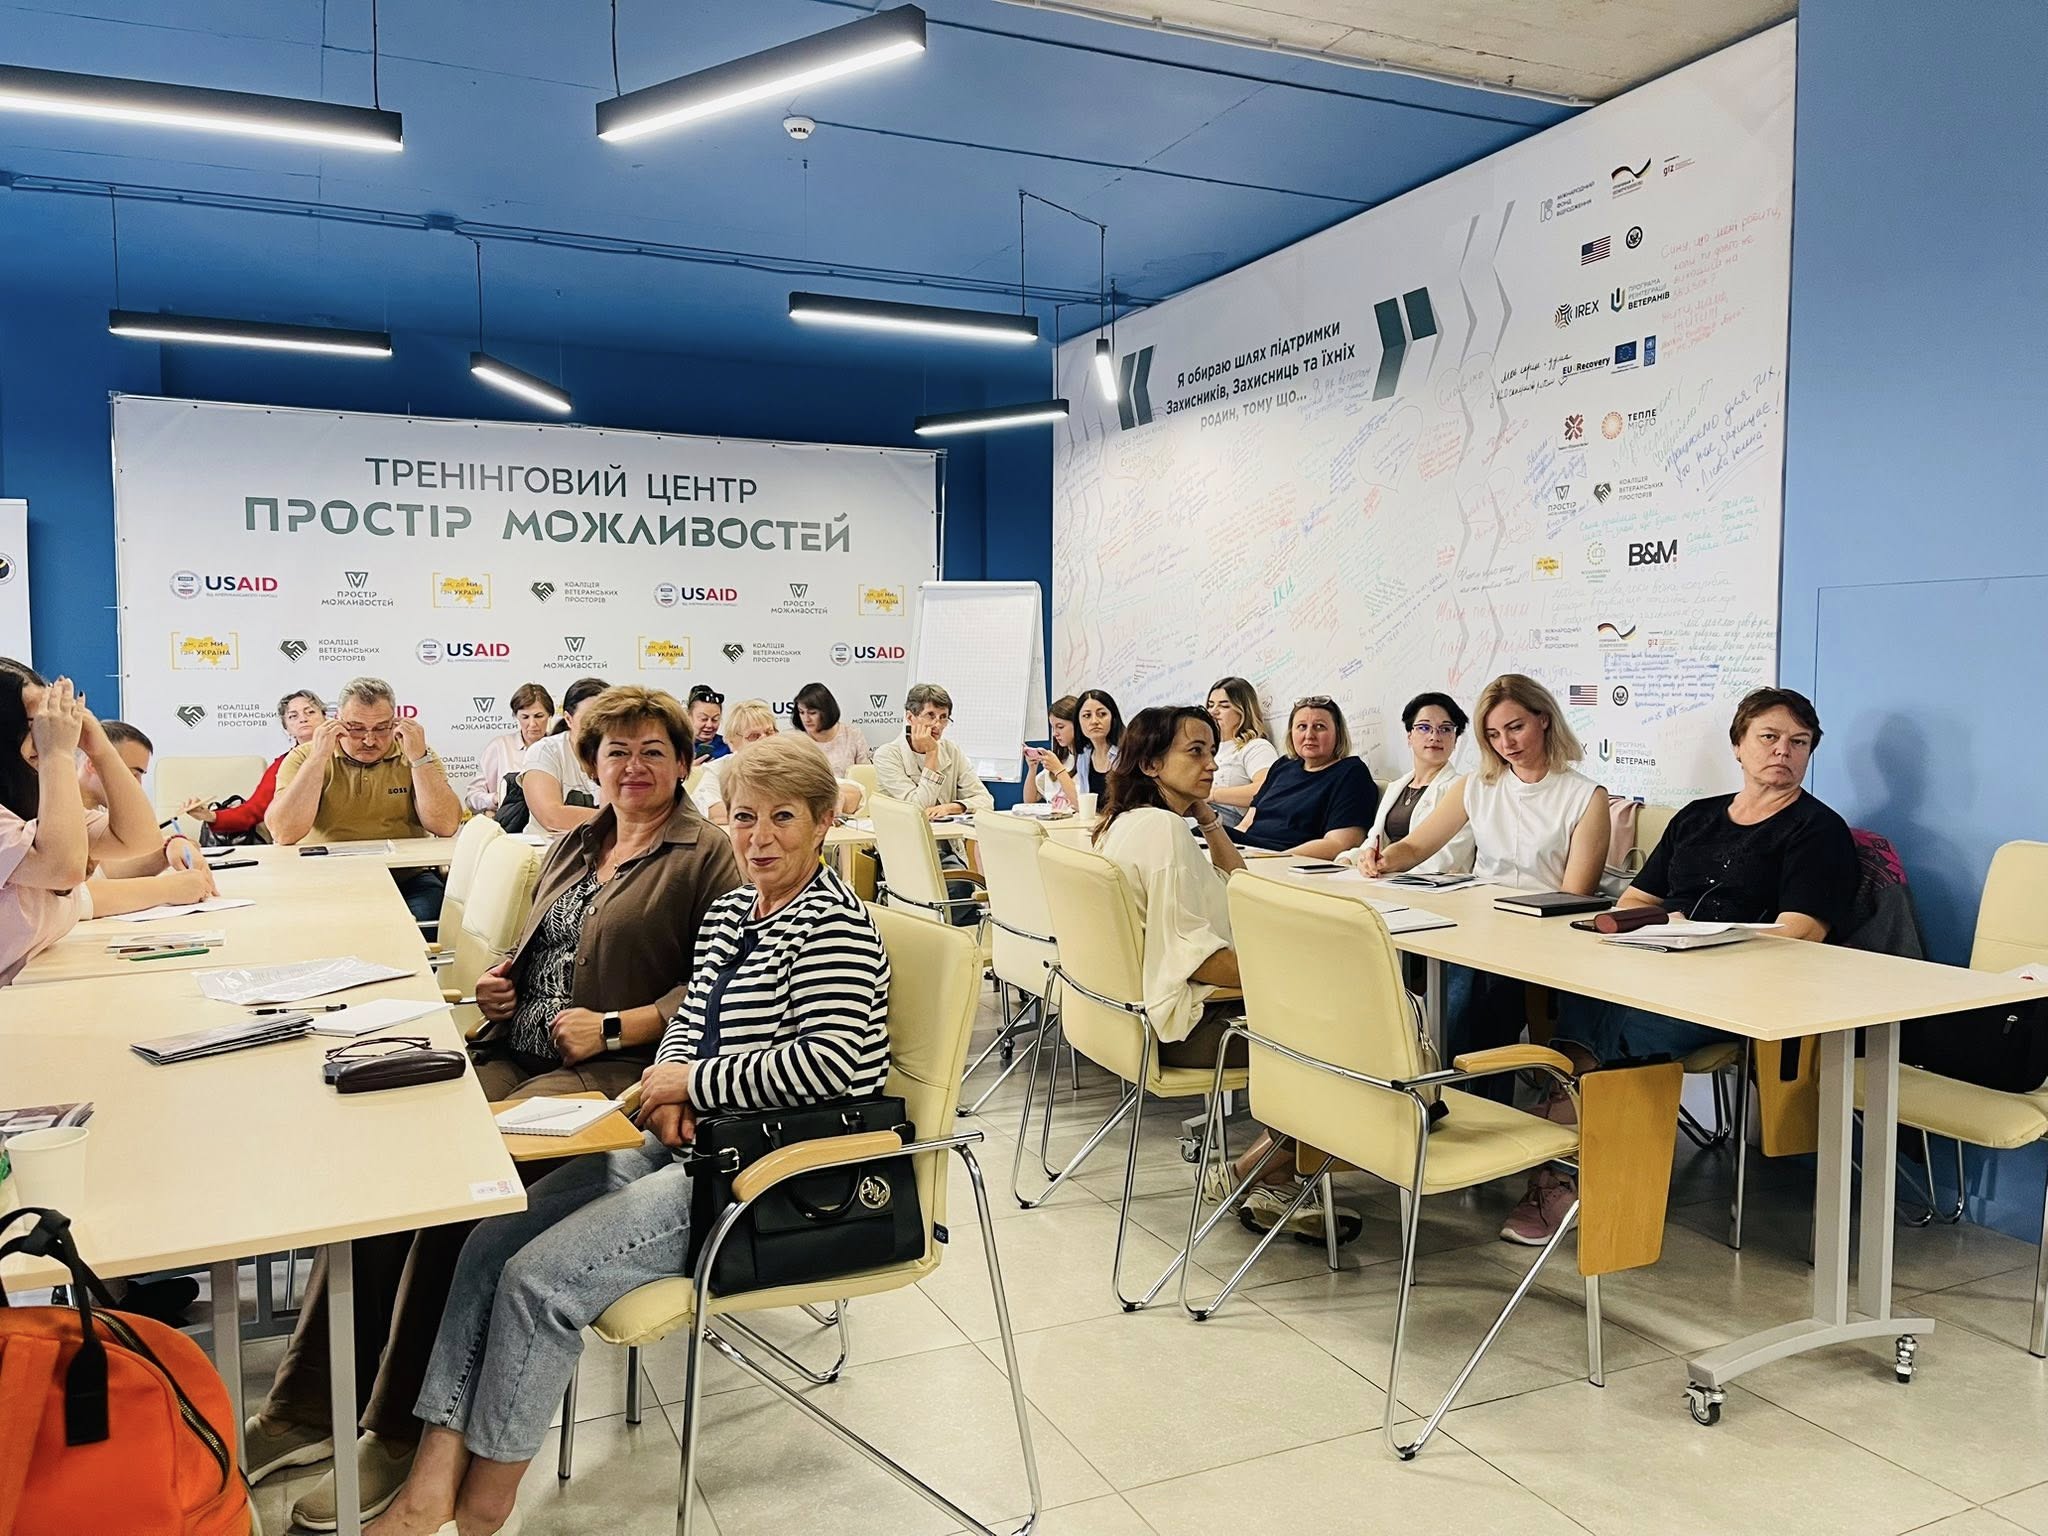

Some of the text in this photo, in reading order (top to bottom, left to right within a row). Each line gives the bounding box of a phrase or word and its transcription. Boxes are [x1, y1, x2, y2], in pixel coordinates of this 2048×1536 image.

[1628, 291, 1670, 310] ВЕТЕРАНІВ
[1575, 299, 1600, 319] IREX
[1177, 321, 1340, 389] Я обираю шлях підтримки
[1562, 364, 1573, 375] EU
[1576, 356, 1611, 372] Recovery
[1166, 342, 1355, 415] Захисників, Захисниць та їхніх
[1200, 407, 1239, 430] родин,
[1242, 396, 1272, 416] тому
[1276, 389, 1307, 408] що...
[1627, 408, 1657, 422] ТЕПЛЕ
[365, 457, 758, 506] ТРЕНІНГОВИЙ ЦЕНТР
[1547, 501, 1577, 512] ПРОСТІР
[245, 496, 851, 553] ПРОСТІР МОЖЛИВОСТЕЙ
[205, 575, 279, 591] USAID
[681, 587, 738, 601] USAID
[321, 598, 394, 607] МОЖЛИВОСТЕЙ
[771, 607, 828, 615] МОЖЛИВОСТЕЙ
[446, 643, 510, 657] USAID
[854, 646, 905, 659] USAID
[543, 661, 608, 669] МОЖЛИВОСТЕЙ
[451, 722, 519, 730] МОЖЛИВОСТЕЙ
[1615, 757, 1656, 766] ВЕТЕРАНІВ
